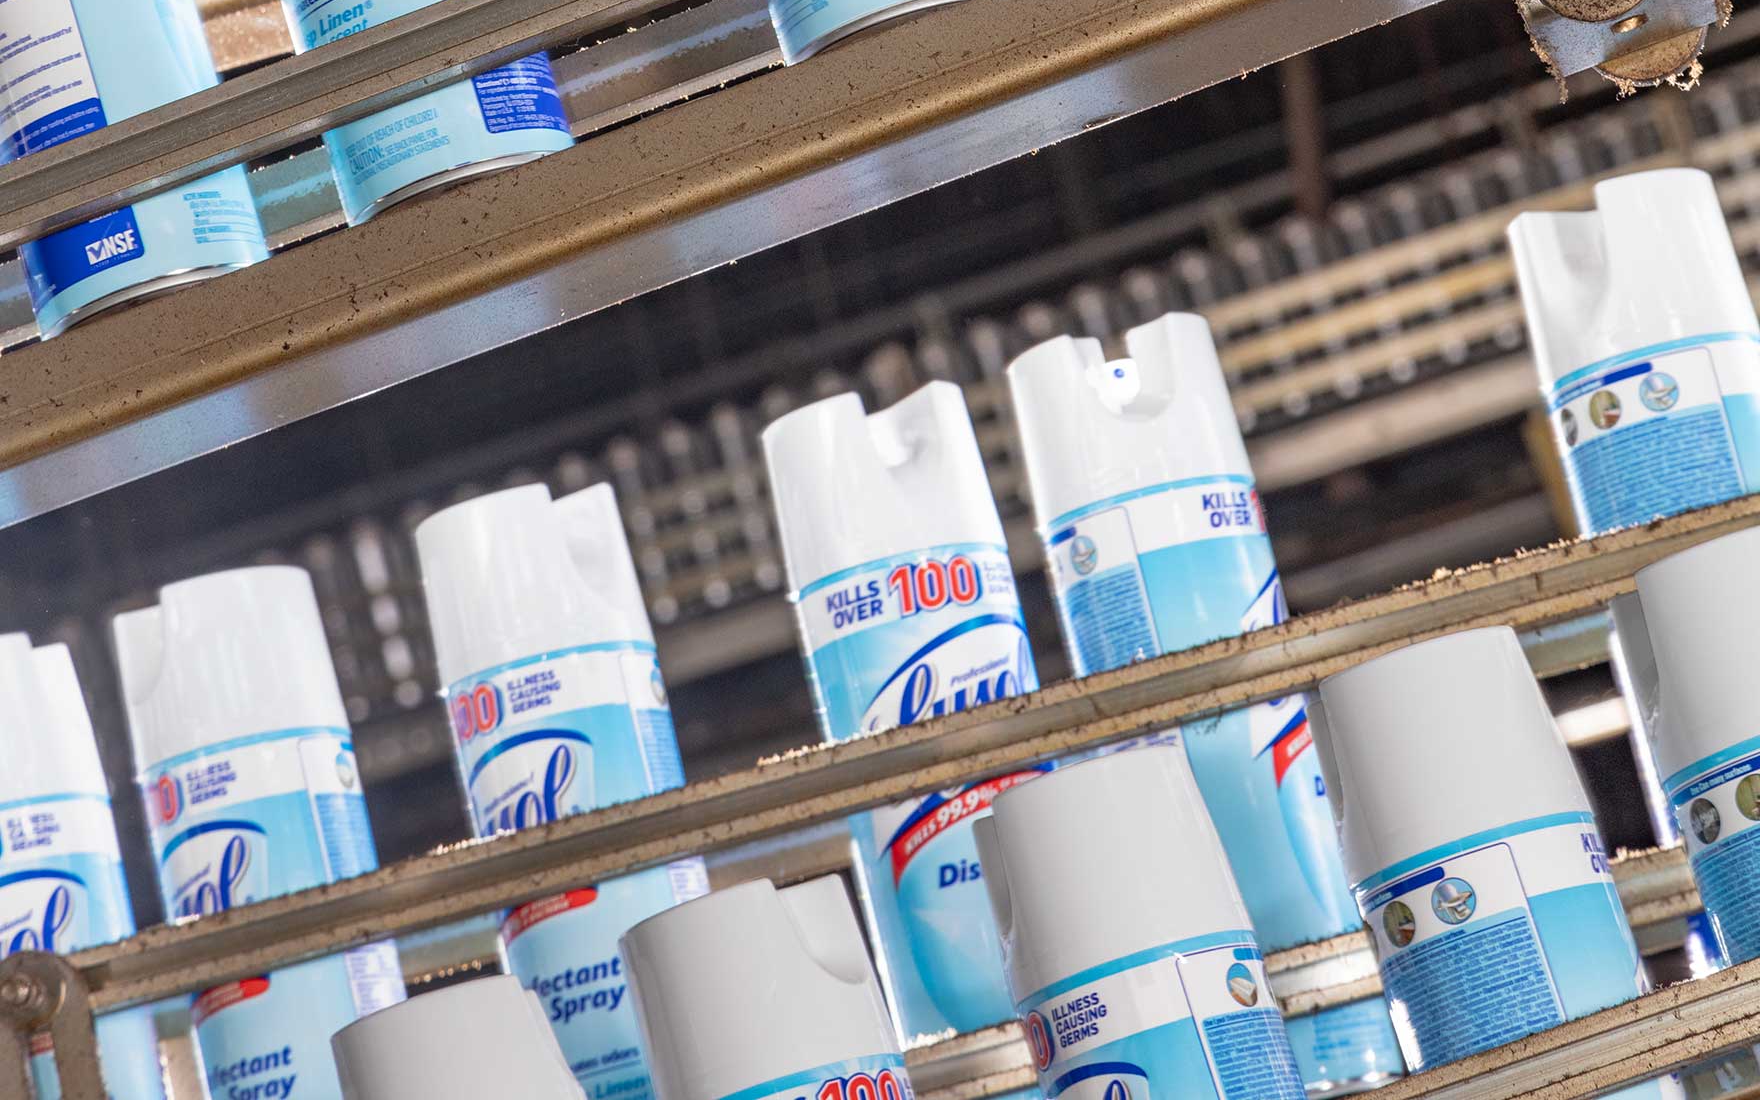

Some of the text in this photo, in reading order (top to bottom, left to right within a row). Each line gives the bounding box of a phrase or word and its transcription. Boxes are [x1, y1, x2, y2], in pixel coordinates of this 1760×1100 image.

[103, 229, 136, 258] NSF
[1202, 492, 1248, 511] KILLS
[1209, 511, 1252, 528] OVER
[826, 580, 880, 613] KILLS
[887, 554, 982, 619] 100
[834, 599, 883, 629] OVER
[551, 984, 627, 1024] Spray
[1052, 992, 1100, 1022] ILLNESS
[1056, 1003, 1107, 1036] CAUSING
[1060, 1022, 1100, 1049] GERMS
